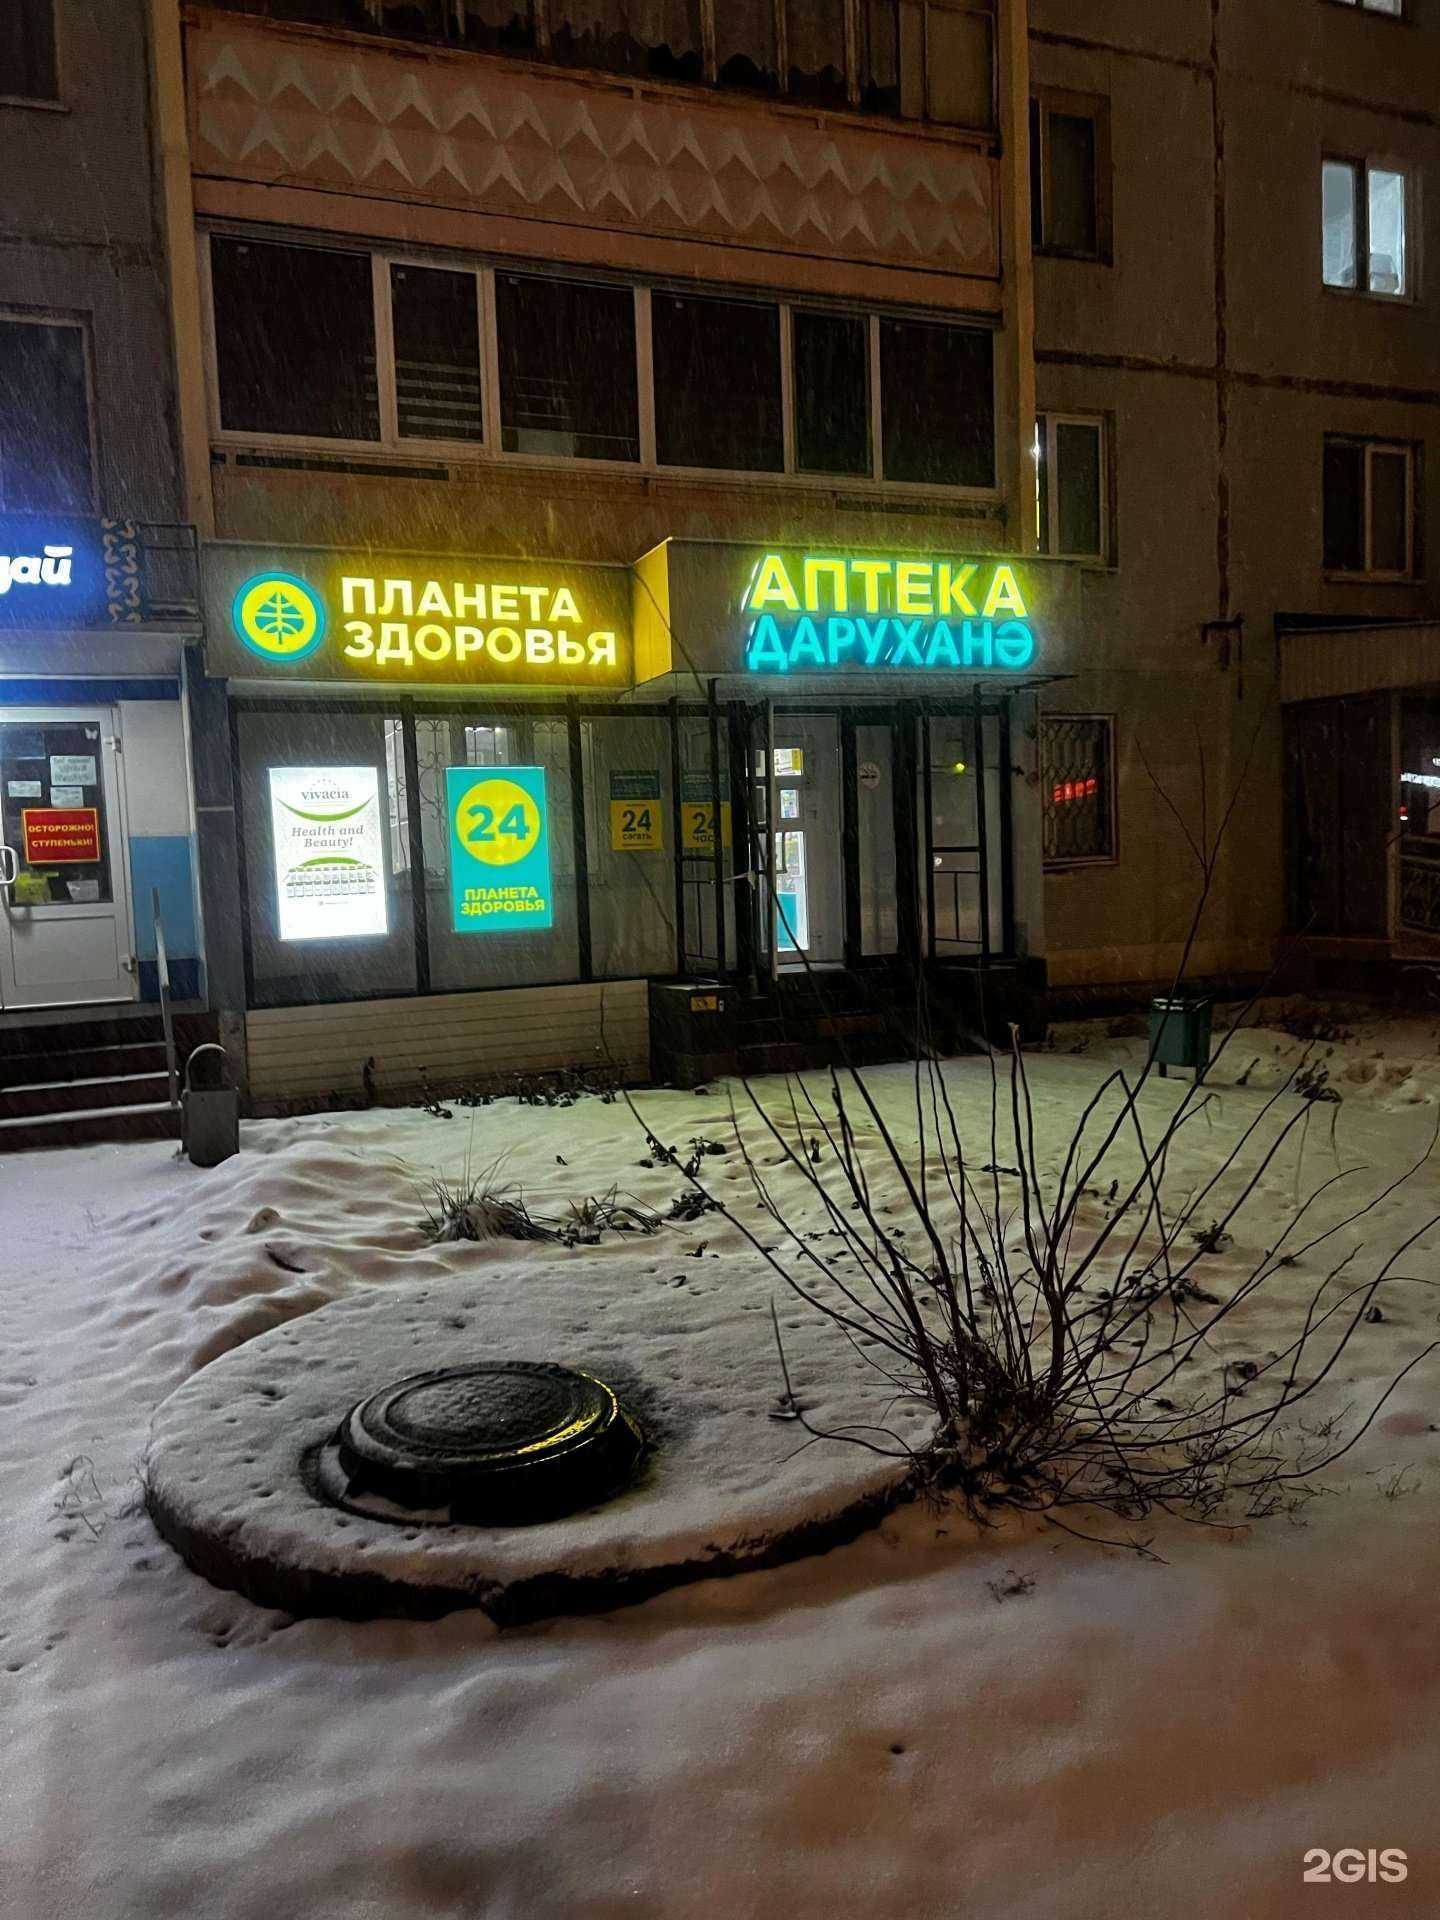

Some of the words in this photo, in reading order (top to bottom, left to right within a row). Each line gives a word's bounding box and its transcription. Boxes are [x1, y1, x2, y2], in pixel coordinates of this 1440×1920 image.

[748, 554, 1029, 617] АПТЕКА
[341, 576, 583, 623] ПЛАНЕТА
[343, 620, 618, 666] ЗДОРОВЬЯ
[748, 614, 1035, 670] ДАРУХАНӘ
[301, 788, 350, 801] vivacia
[28, 824, 95, 833] ОСТОРОЖНО!
[466, 803, 530, 842] 24
[622, 809, 652, 833] 24
[292, 825, 336, 838] Health
[339, 824, 365, 837] and
[31, 837, 94, 847] СТУПЕНЬКИ!
[303, 836, 354, 849] Beauty!
[464, 886, 539, 902] ПЛАНЕТА
[460, 899, 546, 916] ЗДОРОВЬЯ
